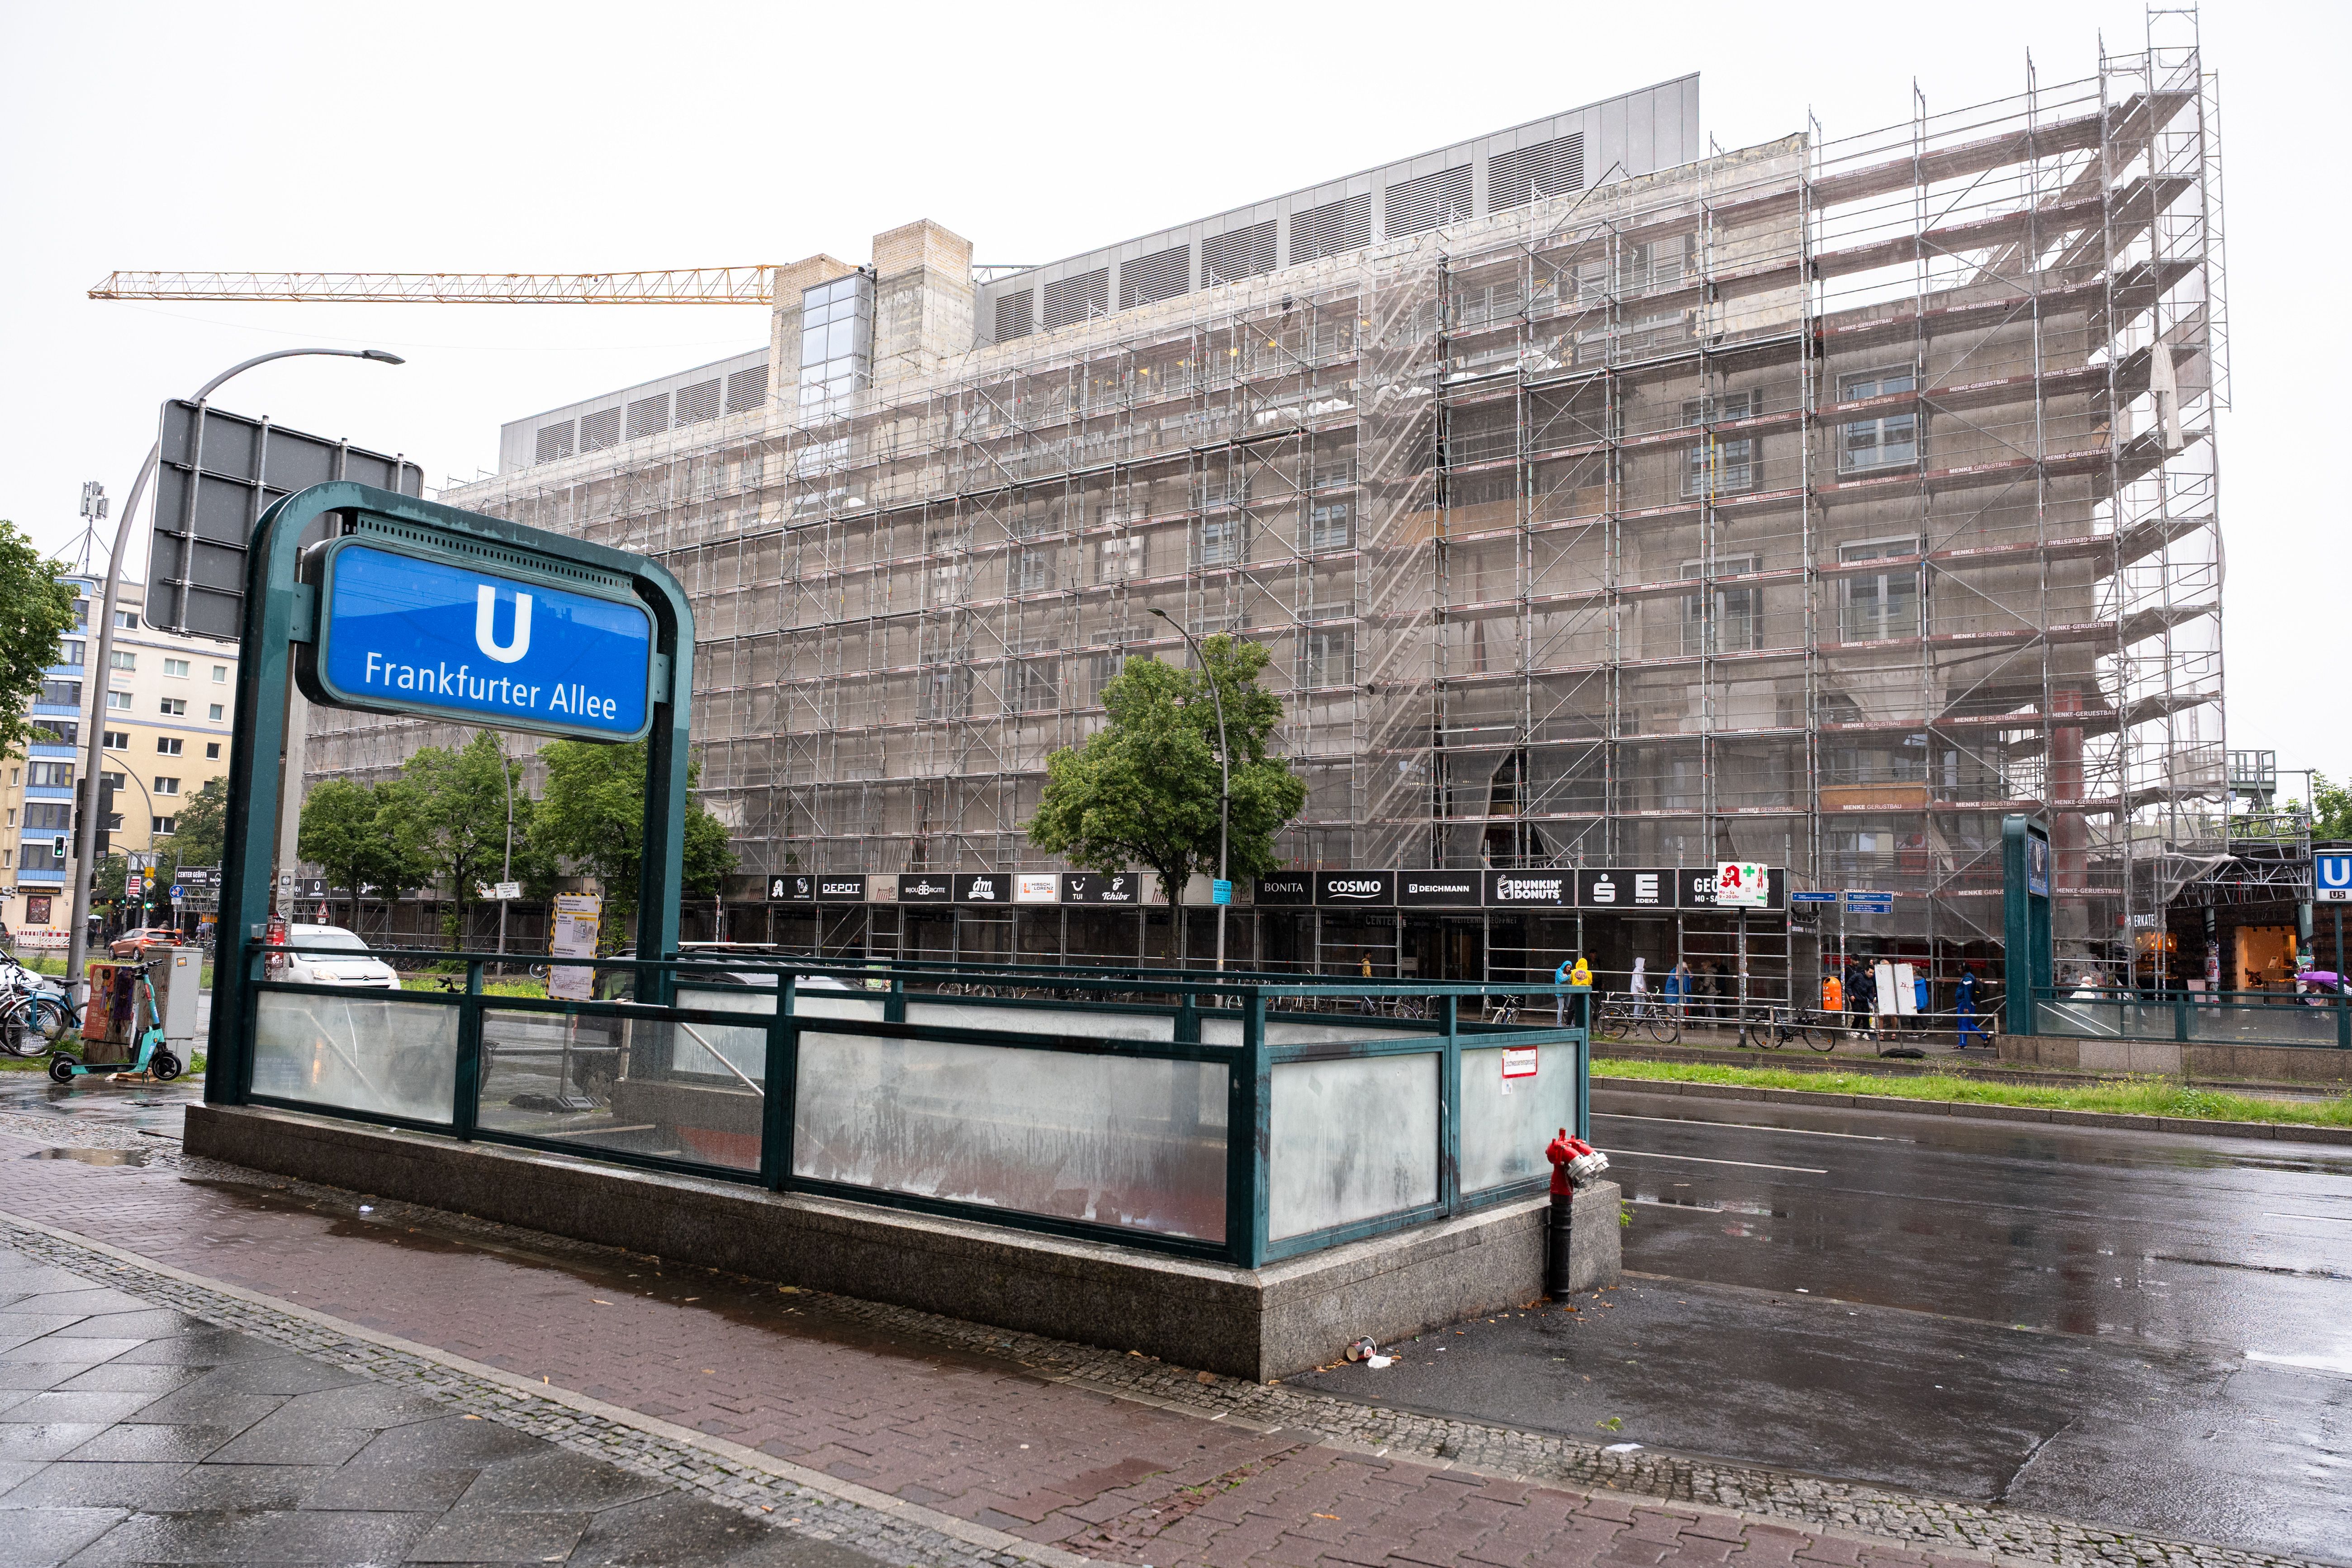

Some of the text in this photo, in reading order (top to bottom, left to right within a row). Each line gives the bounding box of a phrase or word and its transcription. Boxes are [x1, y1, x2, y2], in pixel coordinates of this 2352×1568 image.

[2036, 114, 2097, 131] MENKE-GERUESTBAU
[1944, 136, 2001, 152] MENKE-GERUESTBAU
[1836, 162, 1890, 179] MENKE-GERUESTBAU
[2039, 196, 2101, 212] MENKE-GERUESTBAU
[1945, 216, 2004, 232] MENKE-GERUESTBAU
[1837, 240, 1892, 255] MENKE-GERUESTBAU
[2041, 279, 2103, 295] MENKE-GERUESTBAU
[1947, 300, 2005, 313] MENKE-GERUESTBAU
[1838, 318, 1892, 332] MENKE-GERUESTBAU
[2043, 363, 2106, 377] MENKE-GERUESTBAU
[1949, 379, 2008, 392] MENKE-GERUESTBAU
[2045, 448, 2108, 461] MENKE-GERUESTBAU
[475, 584, 533, 663] U
[2049, 622, 2113, 630] MENKE-GERUESTBAU
[365, 652, 616, 720] Frankfurter Allee
[2036, 843, 2040, 872] U
[2324, 859, 2350, 886] U
[823, 884, 860, 892] DEPOT
[973, 876, 992, 891] dm
[1265, 883, 1303, 892] BONITA
[1328, 881, 1381, 892] COSMO
[1515, 880, 1562, 890] DUNKIN'
[1102, 892, 1130, 900] Tchibo
[1515, 890, 1560, 899] DONUTS
